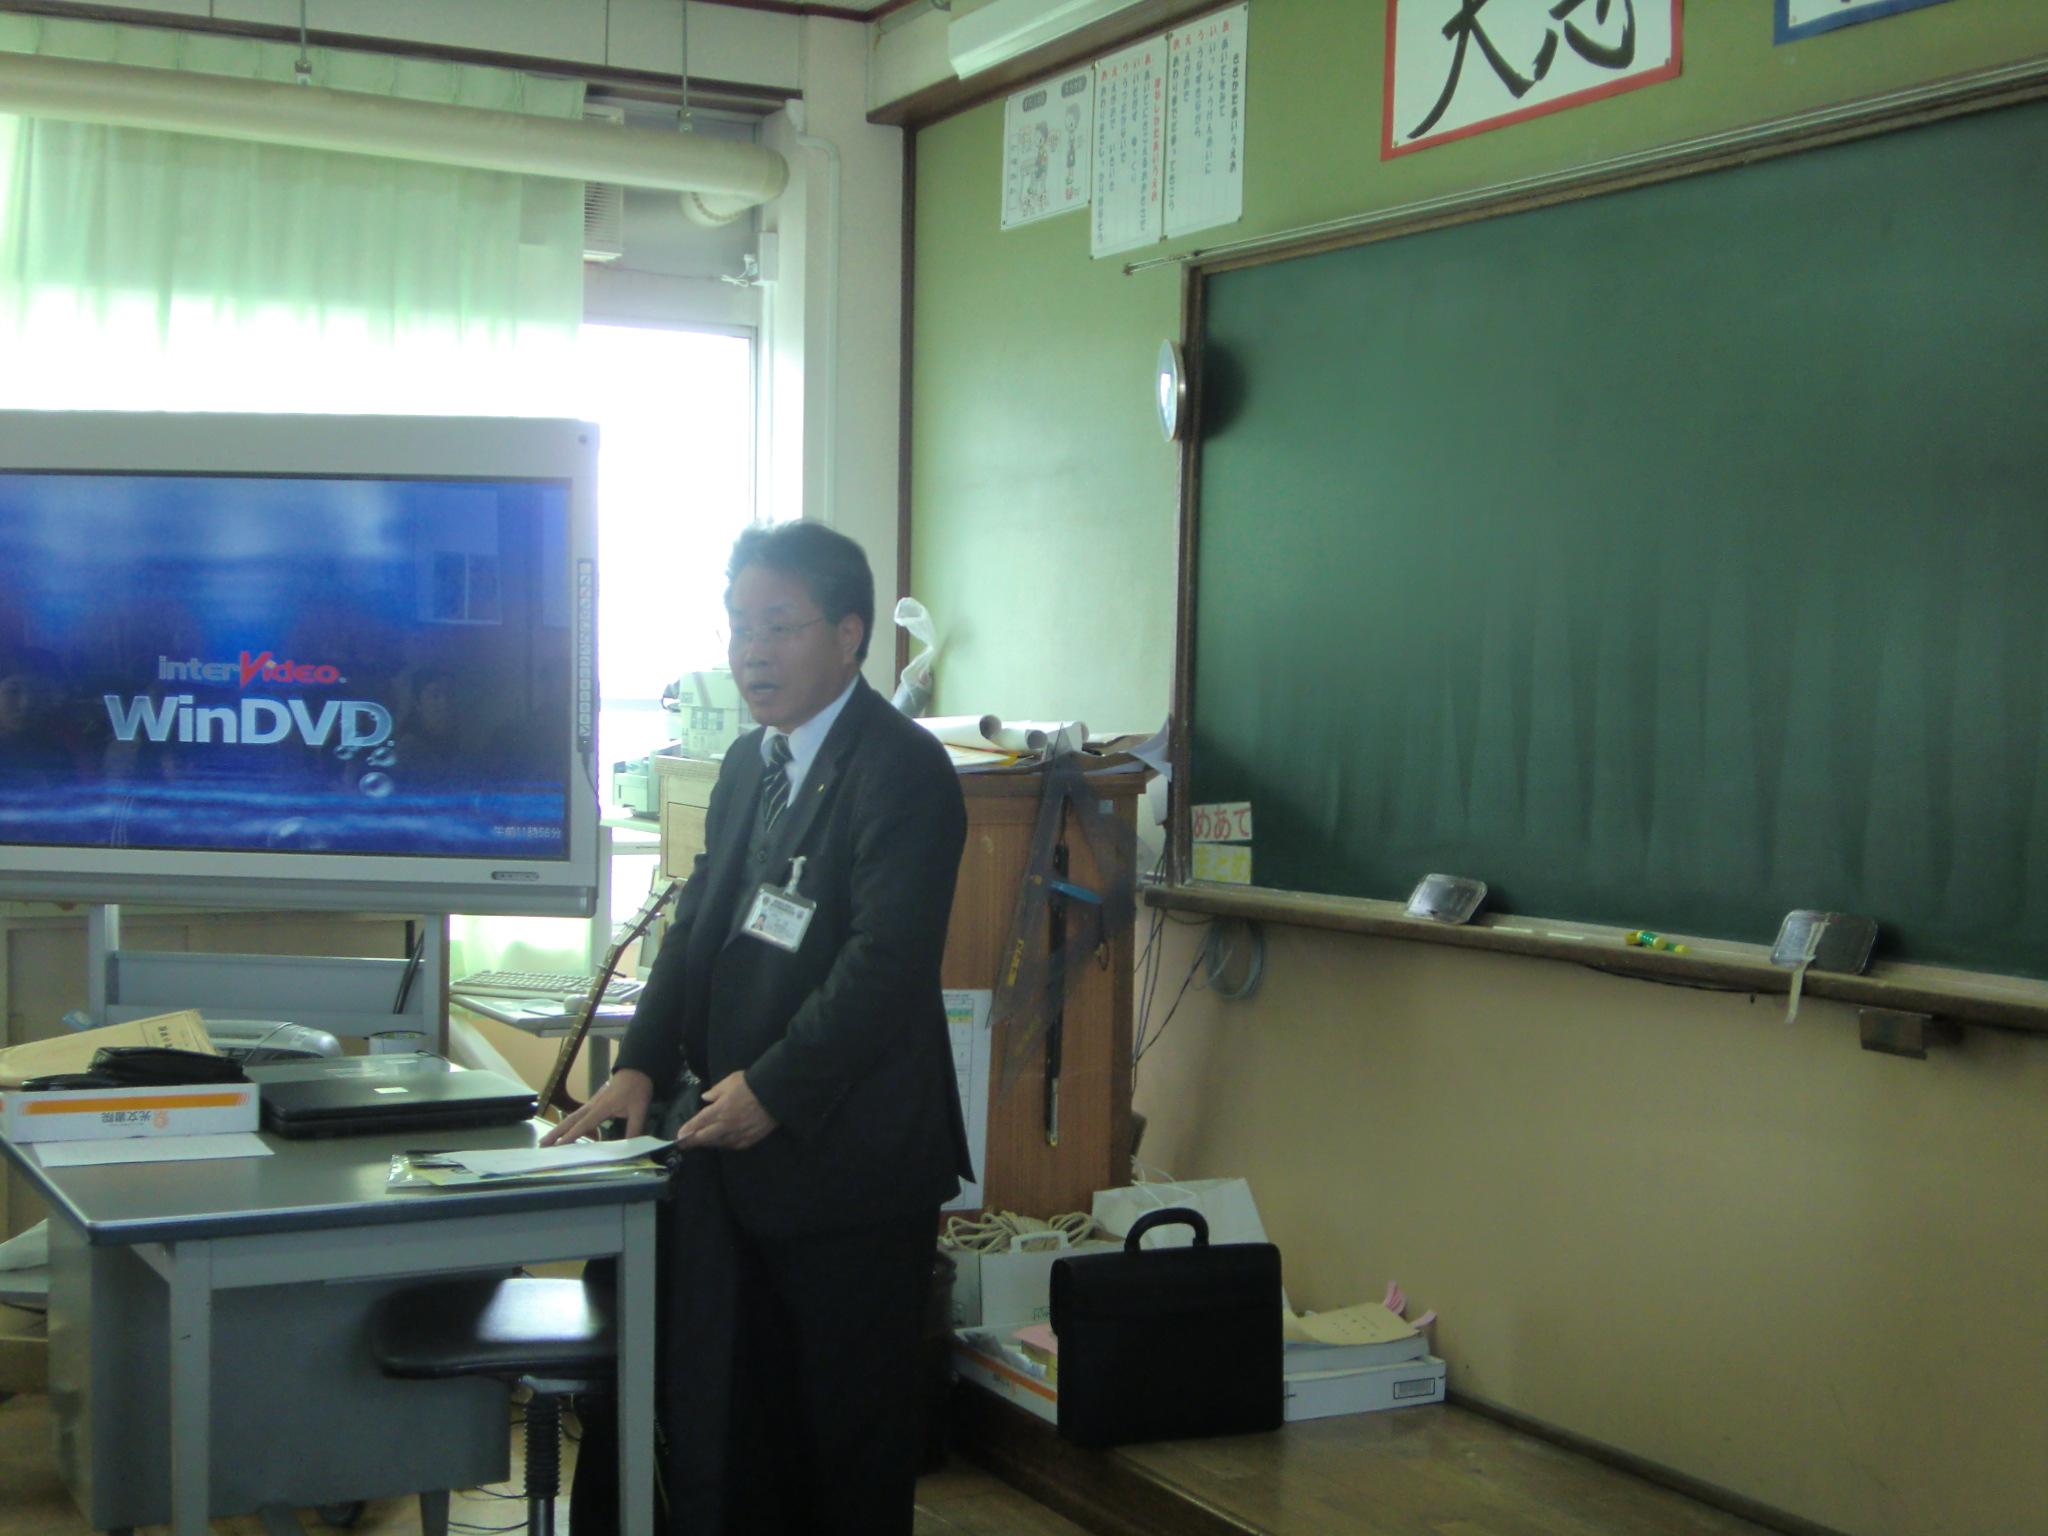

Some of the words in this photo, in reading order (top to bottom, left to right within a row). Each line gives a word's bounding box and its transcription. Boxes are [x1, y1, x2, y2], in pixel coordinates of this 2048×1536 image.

[104, 695, 393, 746] WinDVD
[1194, 805, 1250, 839] めあて
